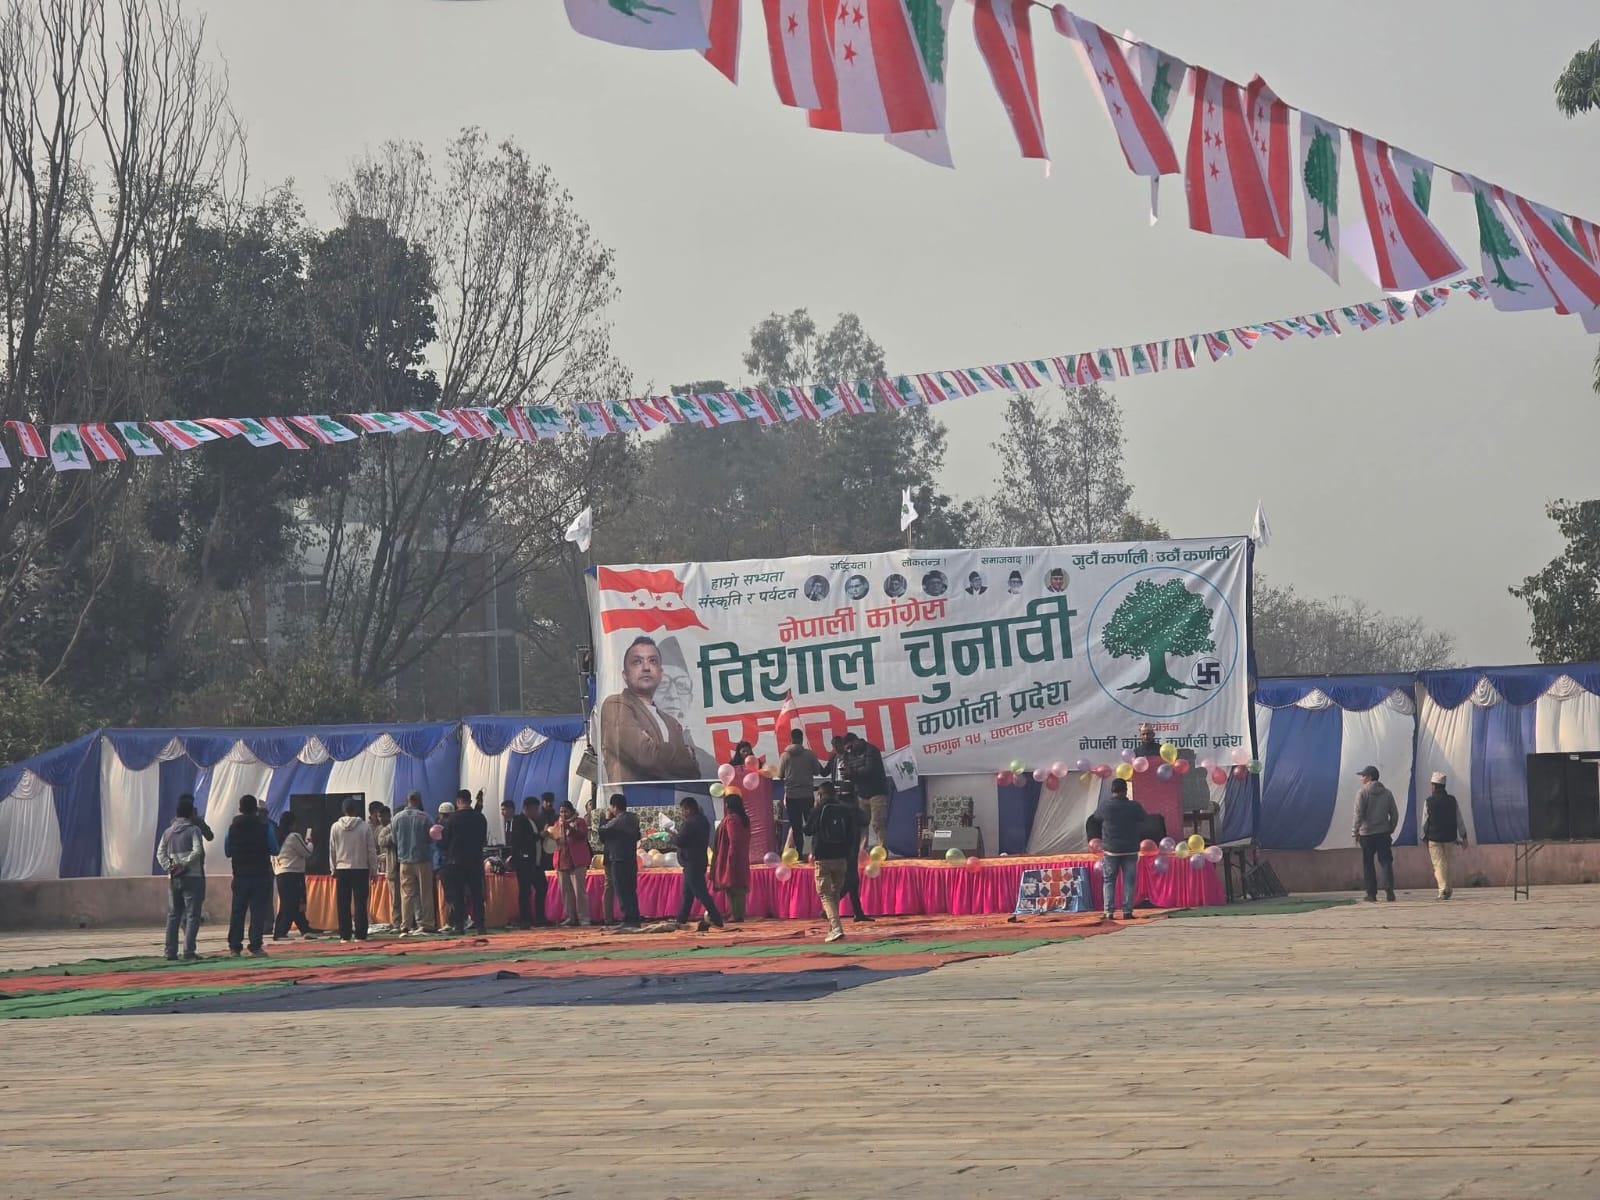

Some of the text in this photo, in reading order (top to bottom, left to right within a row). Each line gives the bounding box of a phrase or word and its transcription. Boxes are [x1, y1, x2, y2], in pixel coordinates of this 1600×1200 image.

[1101, 548, 1148, 565] कर्णाली
[1183, 545, 1230, 562] कर्णाली
[711, 571, 784, 591] हाम्रो सभ्यता
[698, 590, 743, 610] संस्कृति
[747, 592, 756, 605] र
[778, 597, 948, 643] नेपाली कांग्रेस
[697, 594, 1078, 709] विशाल चुनावी
[916, 679, 1072, 736] कर्णाली प्रदेश
[704, 695, 920, 770] सभा
[1079, 735, 1118, 750] नेपाली
[1212, 732, 1243, 749] प्रदेश
